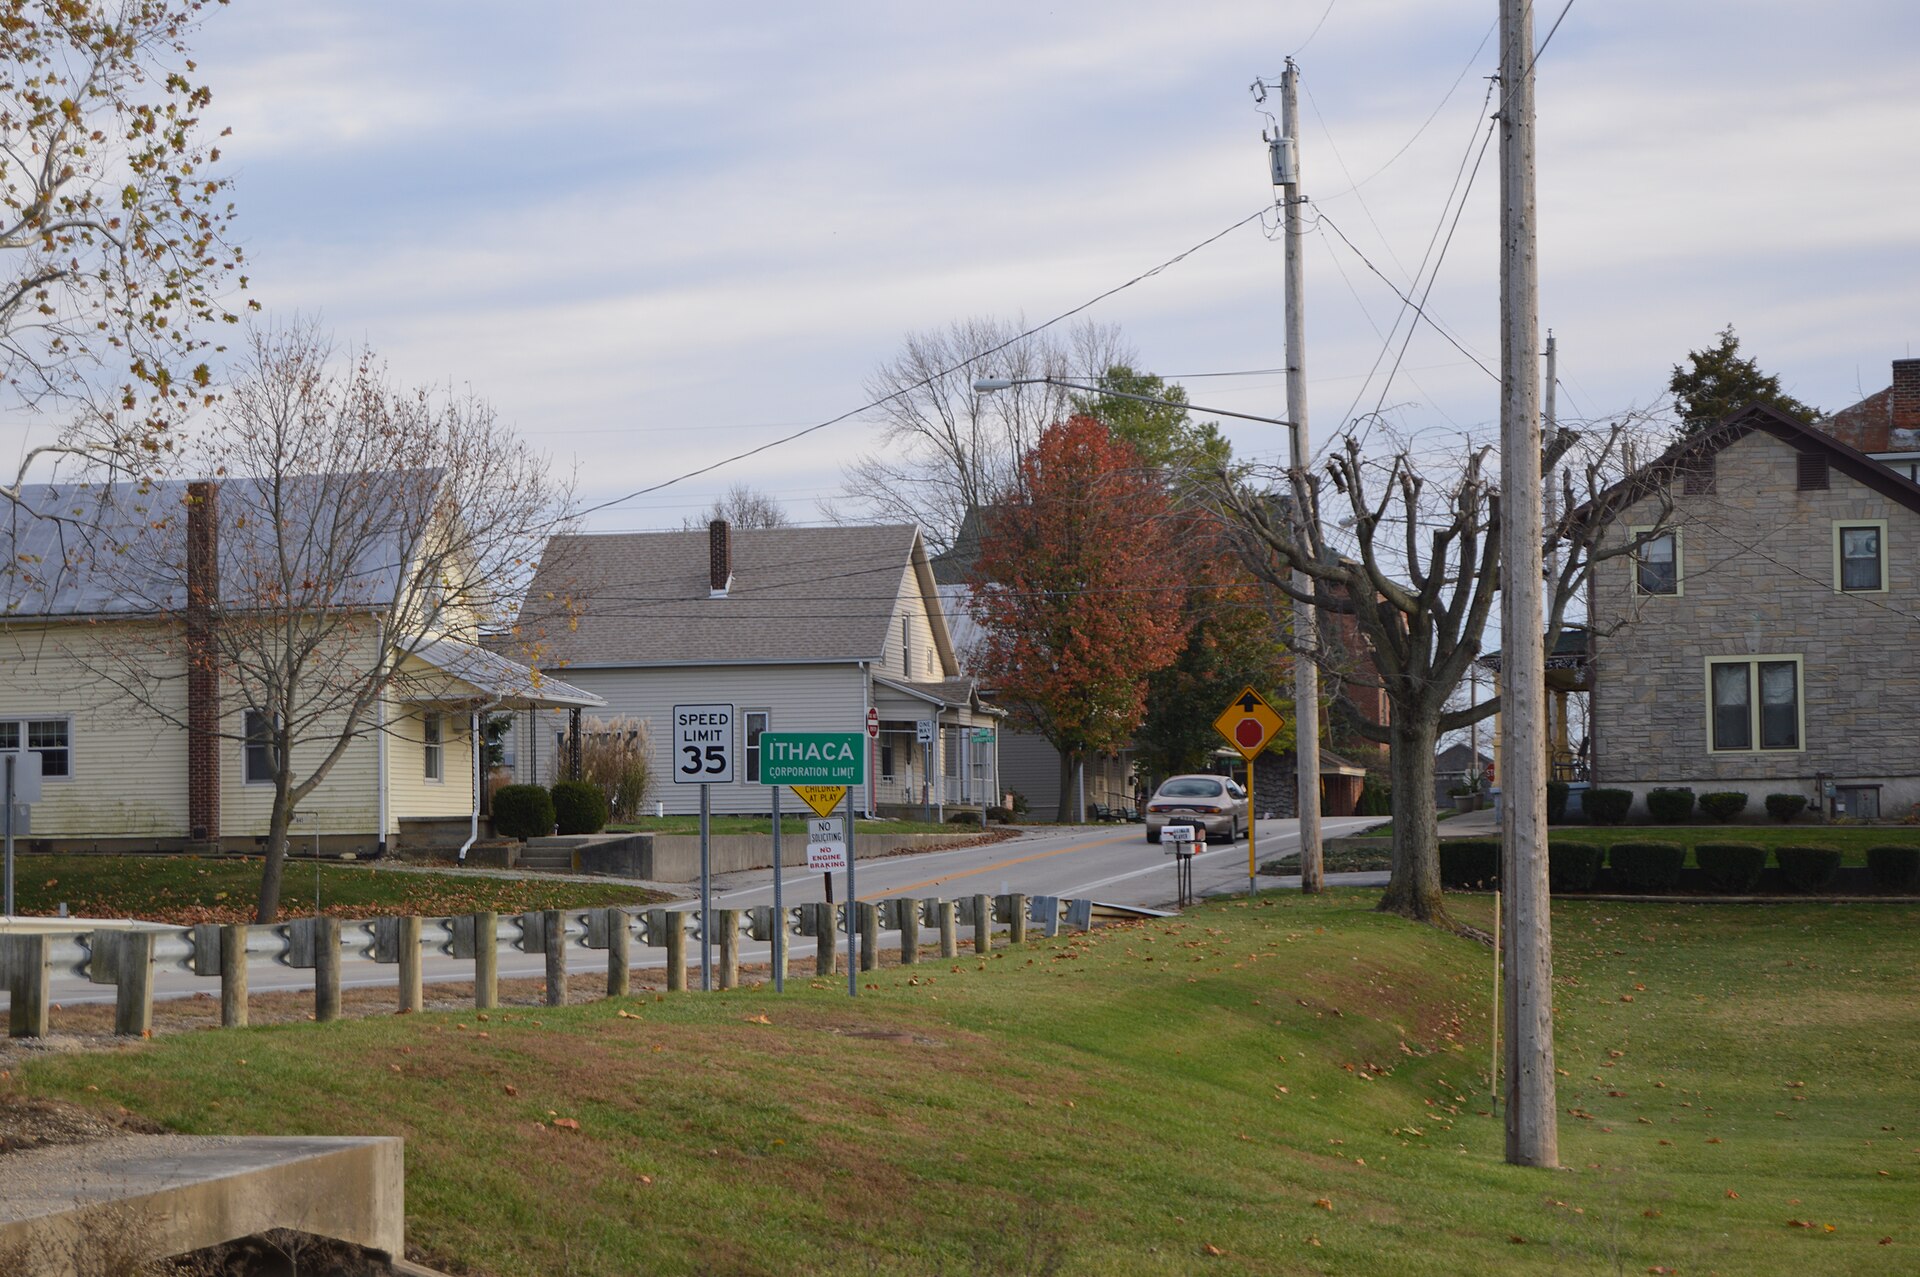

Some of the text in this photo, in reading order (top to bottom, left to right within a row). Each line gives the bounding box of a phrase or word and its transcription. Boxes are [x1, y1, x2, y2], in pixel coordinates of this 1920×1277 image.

[679, 713, 728, 726] SPEED
[684, 730, 722, 742] LIMIT
[769, 742, 855, 761] ITHACA
[681, 746, 727, 774] 35
[769, 767, 854, 777] CORPORATION LIMIT
[805, 785, 841, 793] CHILDREN
[809, 793, 837, 802] AT PLAY
[818, 821, 831, 831] NO
[811, 833, 842, 842] SOLICITING
[809, 861, 845, 869] BRAKING
